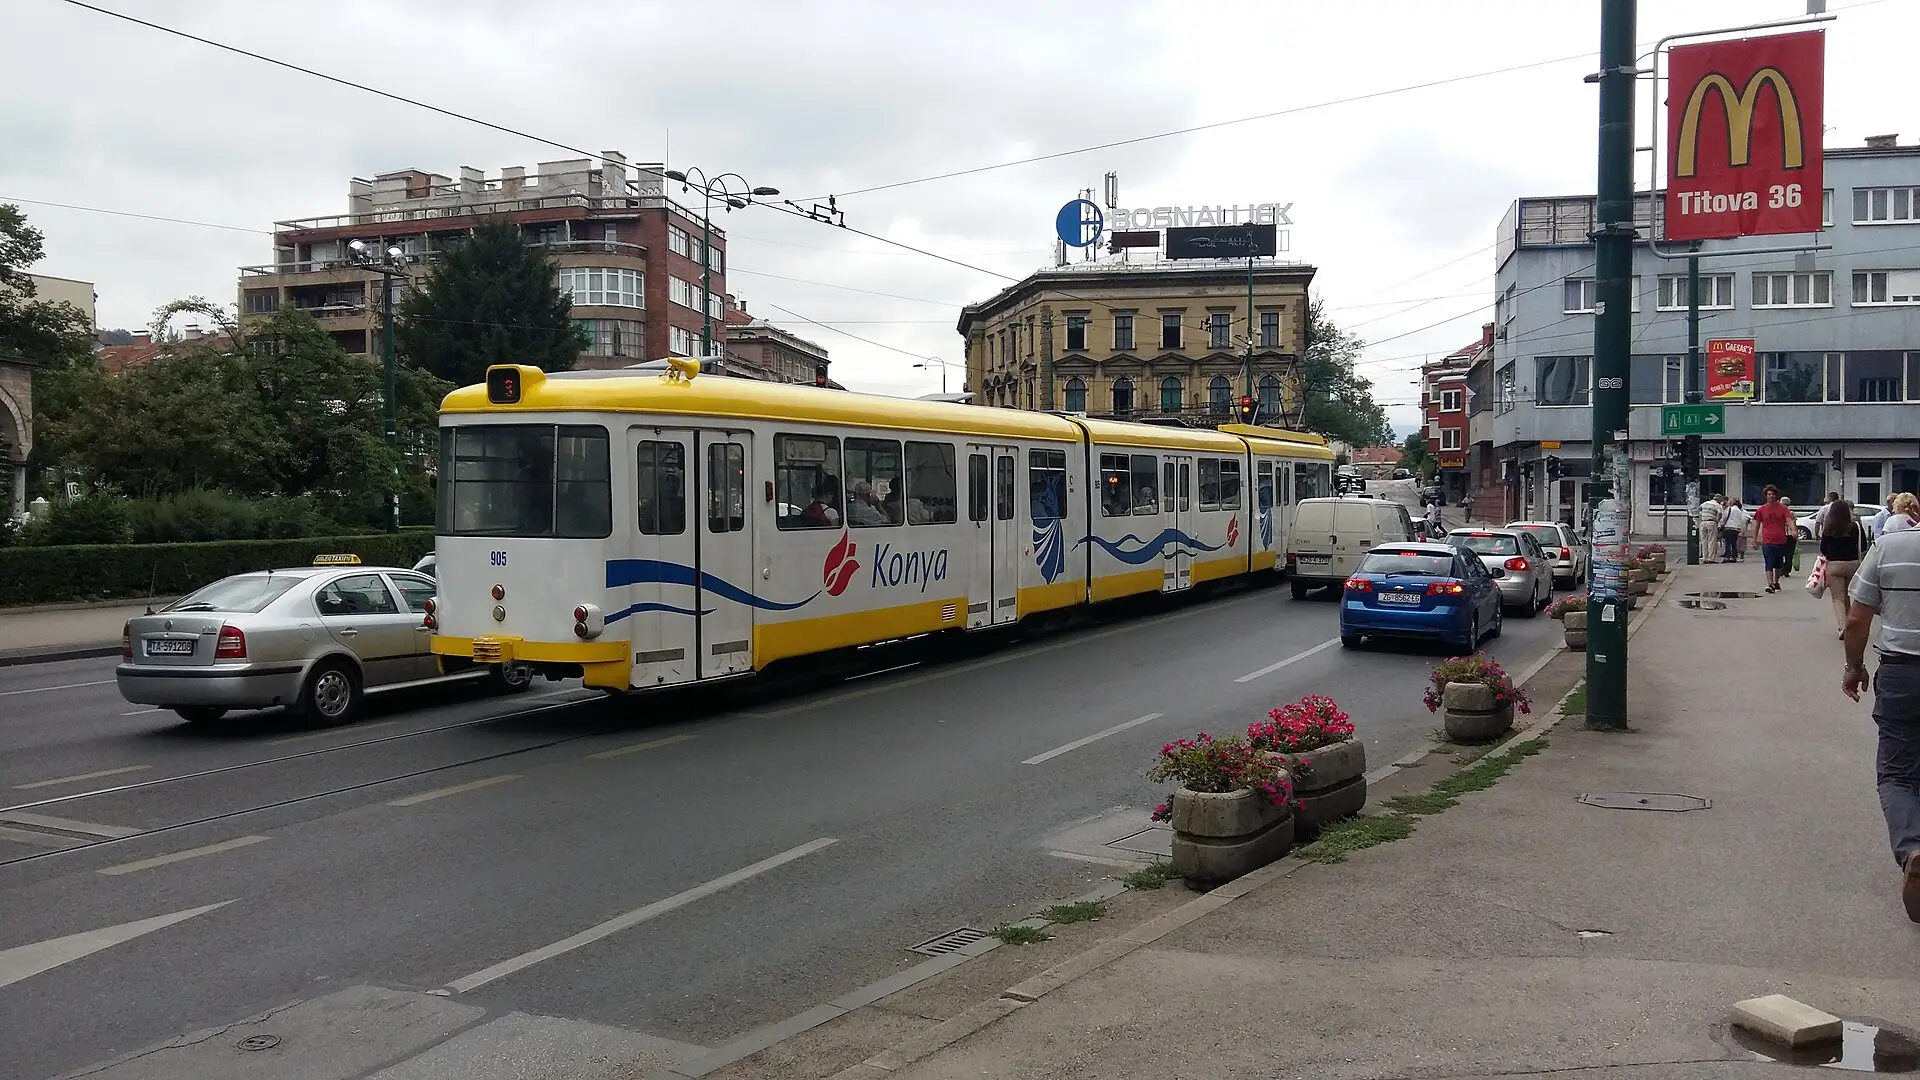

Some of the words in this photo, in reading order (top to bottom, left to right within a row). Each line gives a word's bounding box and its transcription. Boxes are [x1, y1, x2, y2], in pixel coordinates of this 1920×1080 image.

[1678, 191, 1757, 214] Titova
[1768, 184, 1801, 208] 36
[1707, 444, 1773, 457] SANPAOLO
[1777, 444, 1823, 457] BANKA
[490, 551, 507, 567] 905
[871, 543, 948, 594] Konya
